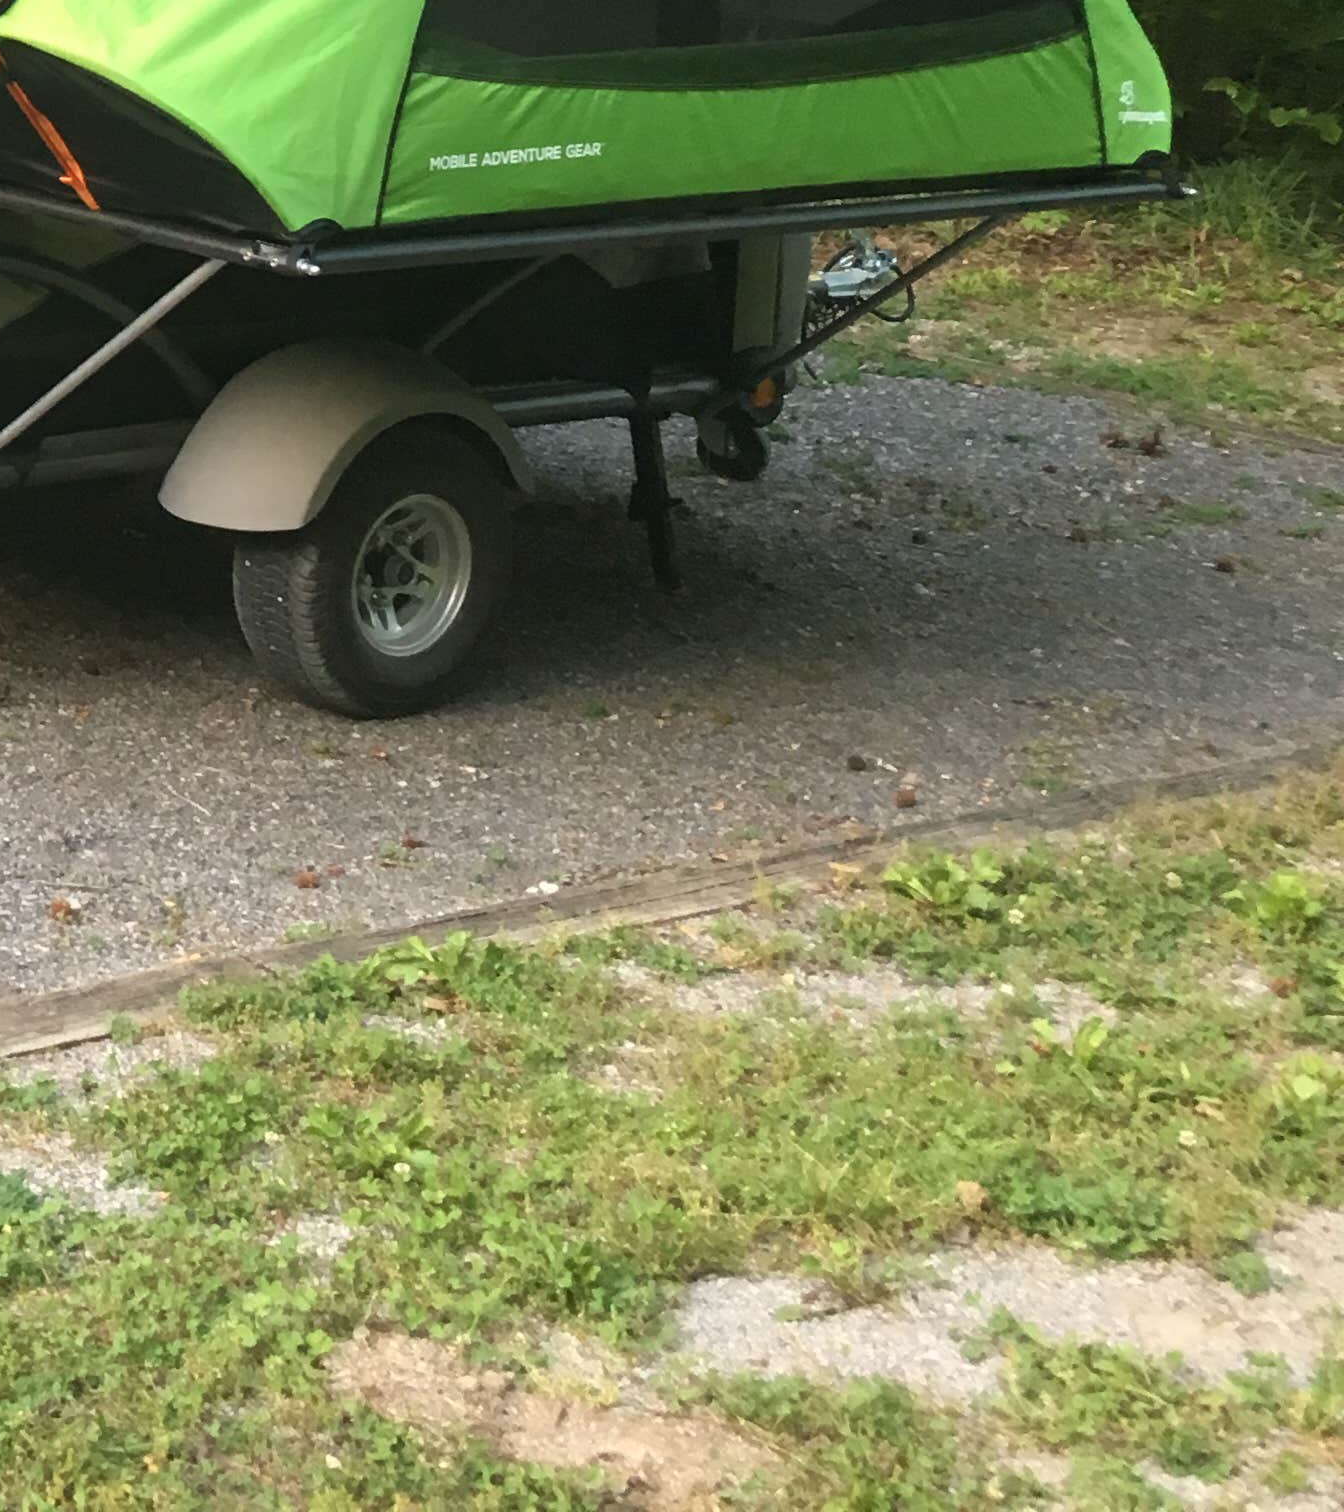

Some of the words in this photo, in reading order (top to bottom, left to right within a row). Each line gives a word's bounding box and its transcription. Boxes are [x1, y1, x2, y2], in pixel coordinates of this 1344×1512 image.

[429, 153, 478, 171] MOBILE
[481, 145, 562, 167] ADVENTURE
[565, 142, 602, 158] GEAR
